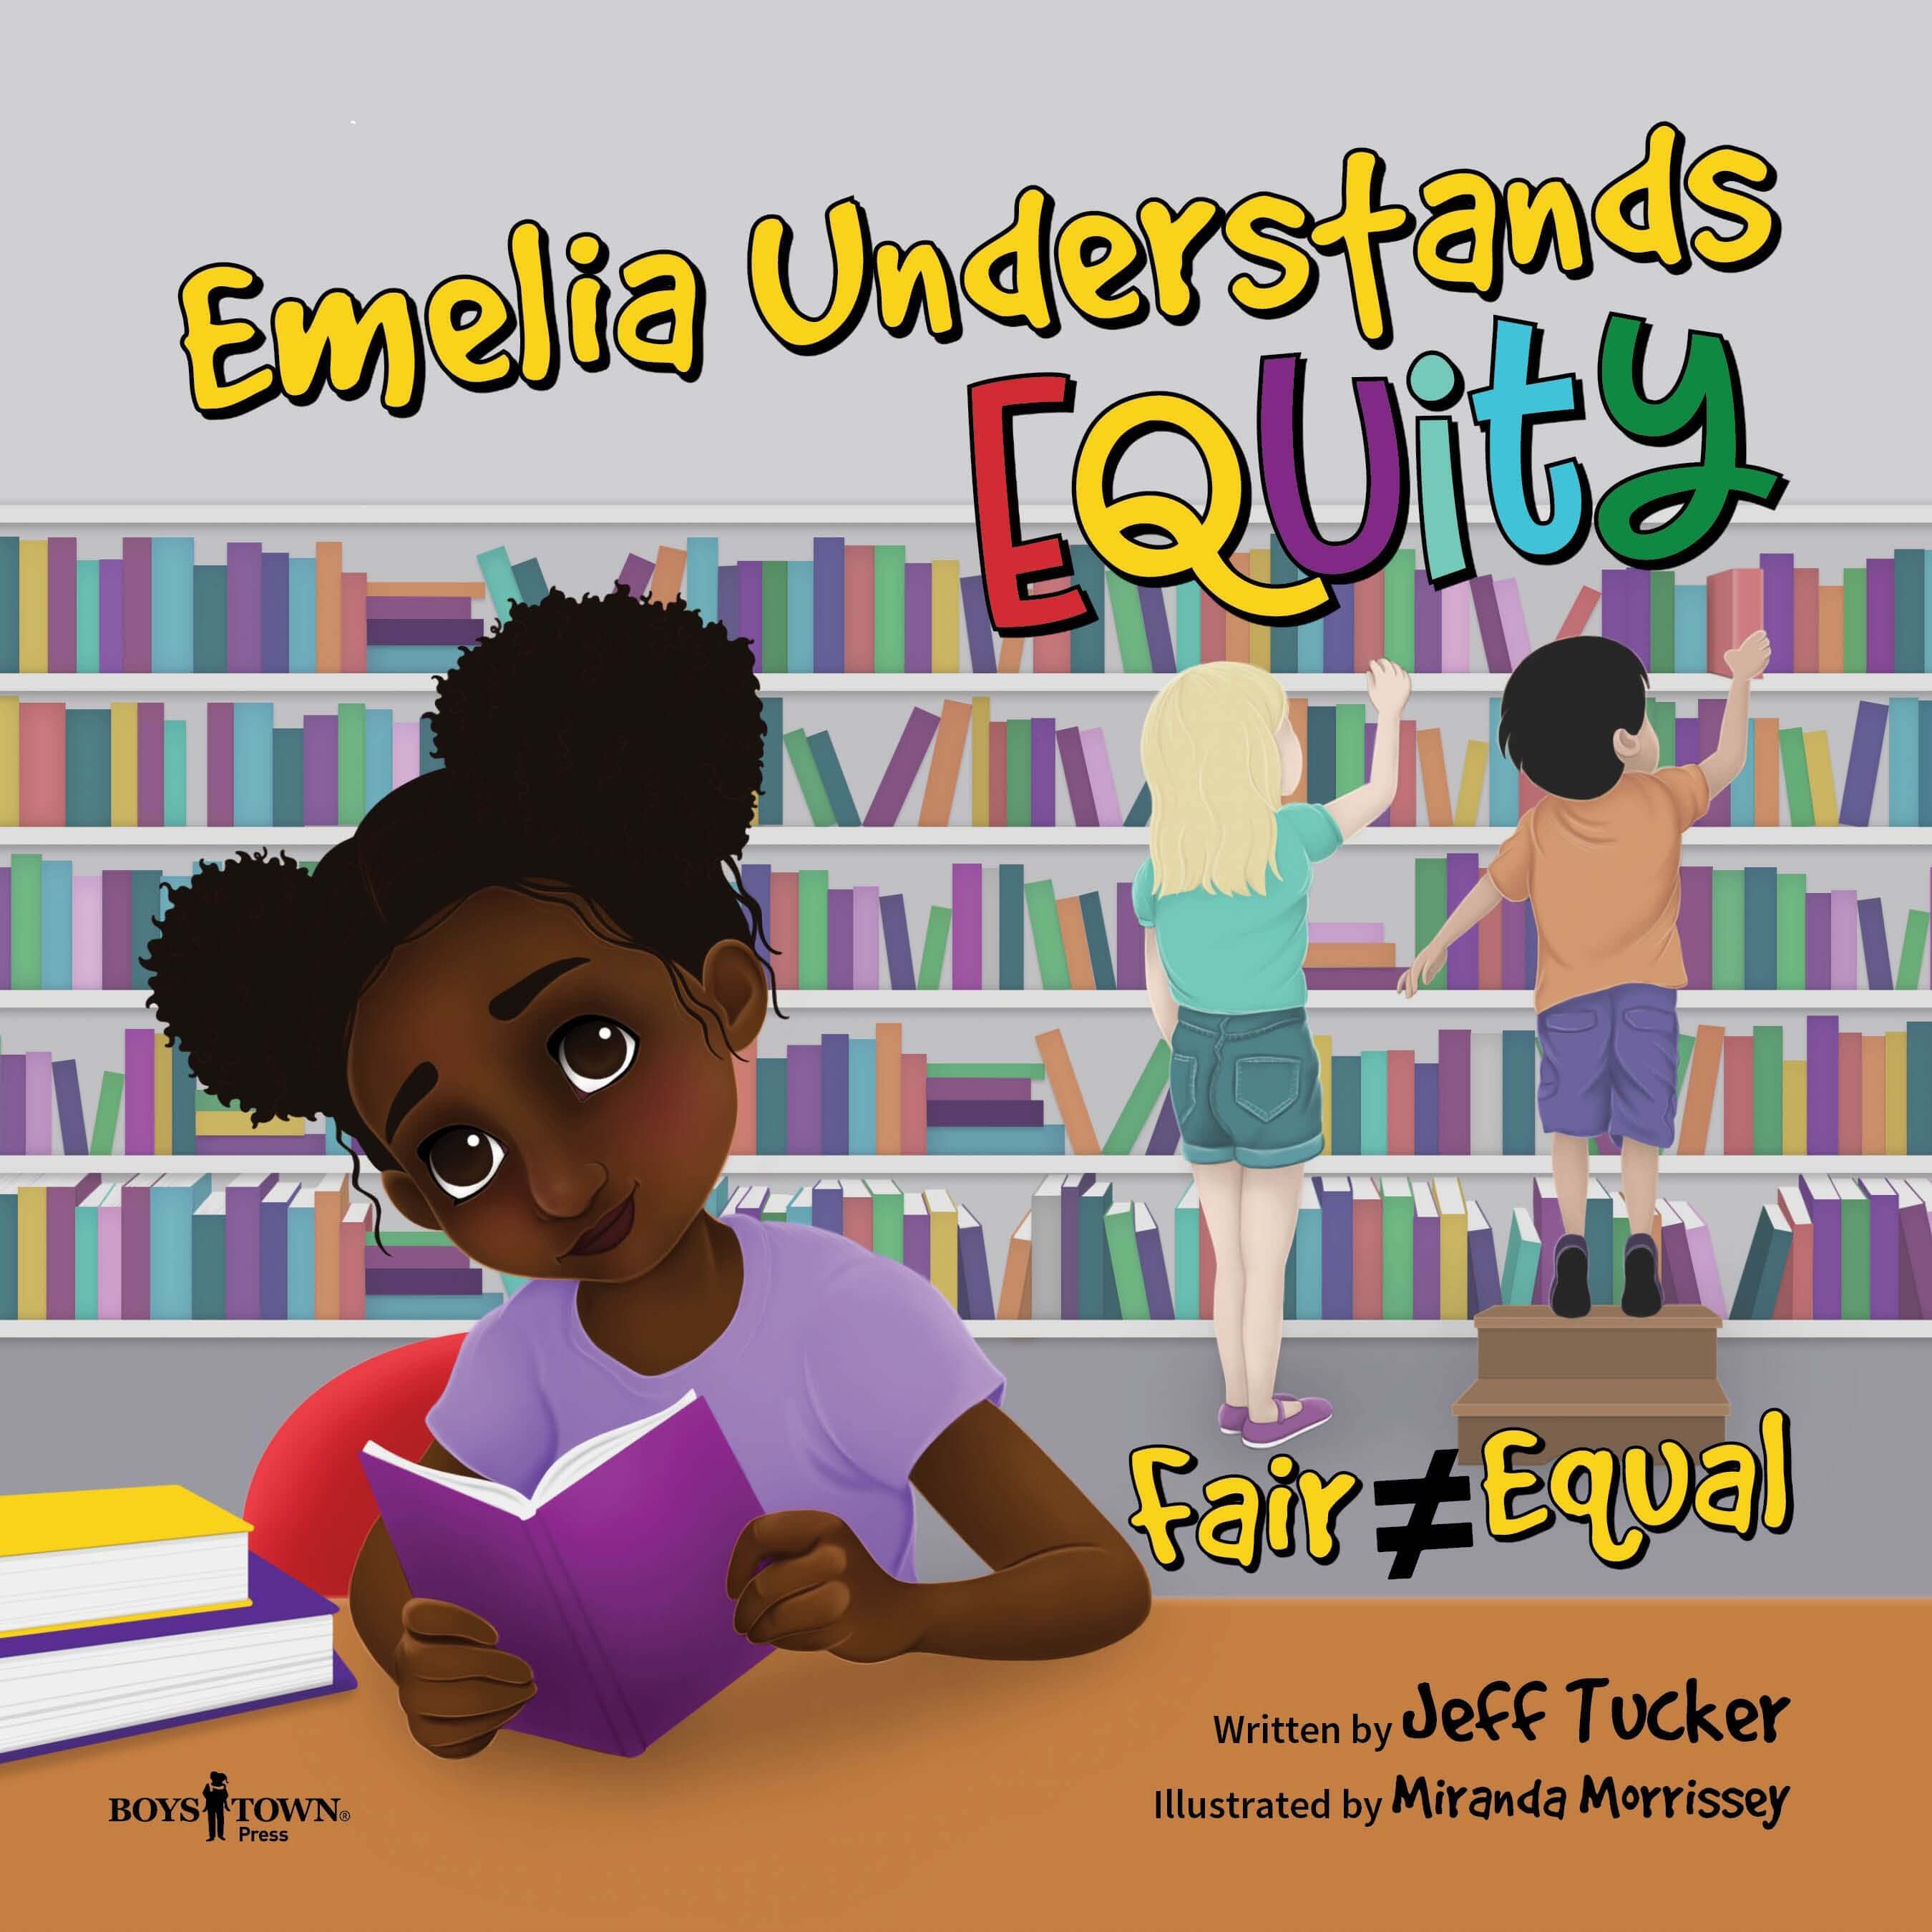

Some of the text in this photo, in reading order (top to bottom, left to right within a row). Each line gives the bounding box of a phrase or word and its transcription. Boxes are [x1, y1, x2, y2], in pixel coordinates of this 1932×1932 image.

[178, 122, 1782, 420] Emelia Understands
[1128, 1445, 1363, 1574] Fair
[1480, 1407, 1794, 1570] Equal
[1213, 1677, 1791, 1752] Written by Jeff Tucker
[108, 1797, 200, 1823] BOYS
[239, 1826, 289, 1843] Press
[1155, 1774, 1791, 1830] Illustrated by Miranda Morrissey
